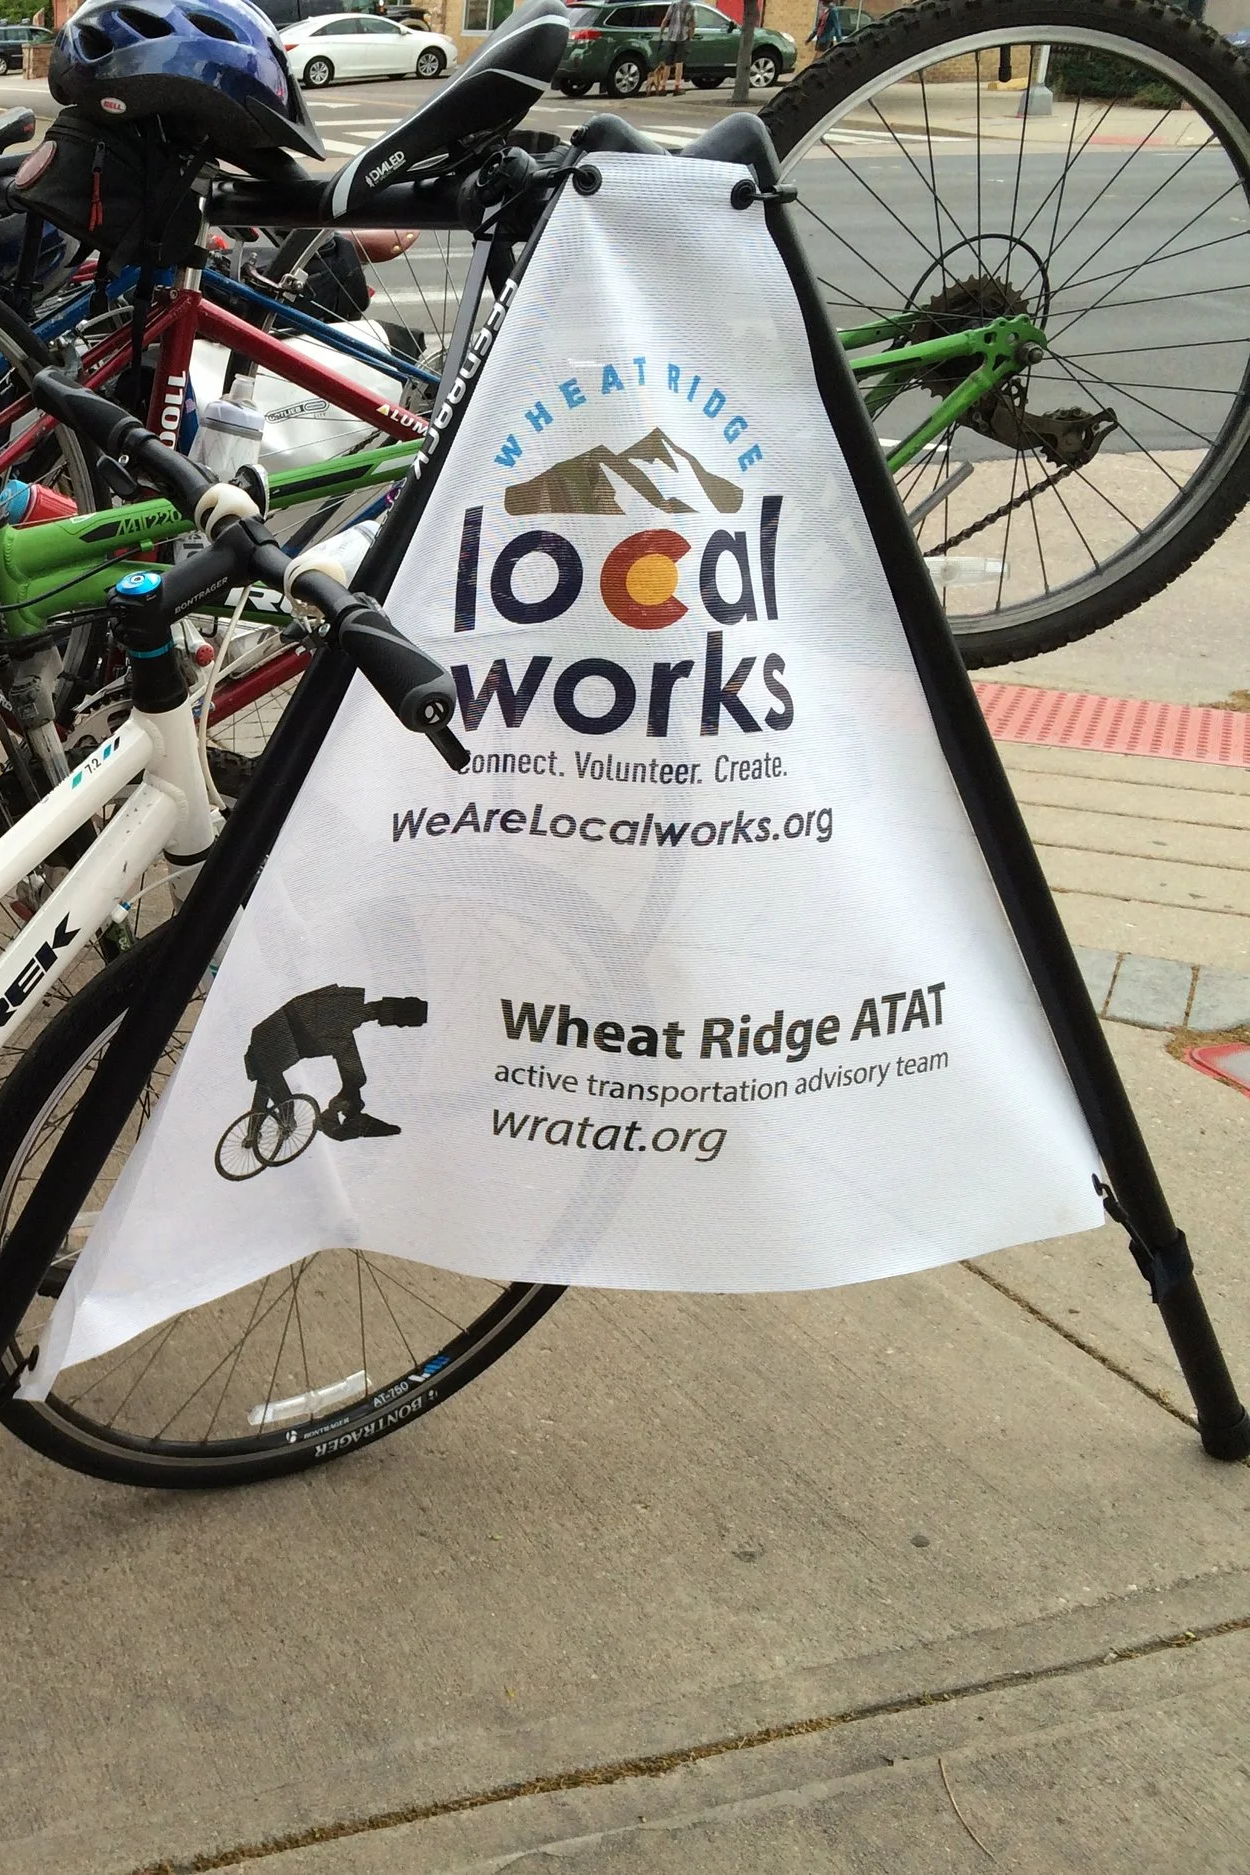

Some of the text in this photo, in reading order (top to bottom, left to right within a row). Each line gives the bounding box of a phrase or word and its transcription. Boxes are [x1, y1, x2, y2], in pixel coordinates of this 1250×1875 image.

[369, 151, 406, 182] DIALED
[494, 356, 764, 472] WHEAT RIDGE
[454, 495, 784, 633] local
[174, 576, 229, 615] BONTRAGER
[450, 631, 795, 738] works
[84, 758, 102, 774] 7.2
[574, 751, 703, 784] Volunteer.
[715, 752, 788, 783] Create.
[391, 801, 834, 848] WeAreLocalworks.org
[500, 981, 946, 1063] Wheat Ridge ATAT
[494, 1050, 949, 1107] active transportation advisory team
[492, 1108, 728, 1163] wratat.org
[373, 1381, 409, 1408] AT-750
[314, 1397, 423, 1458] BONTRAGER
